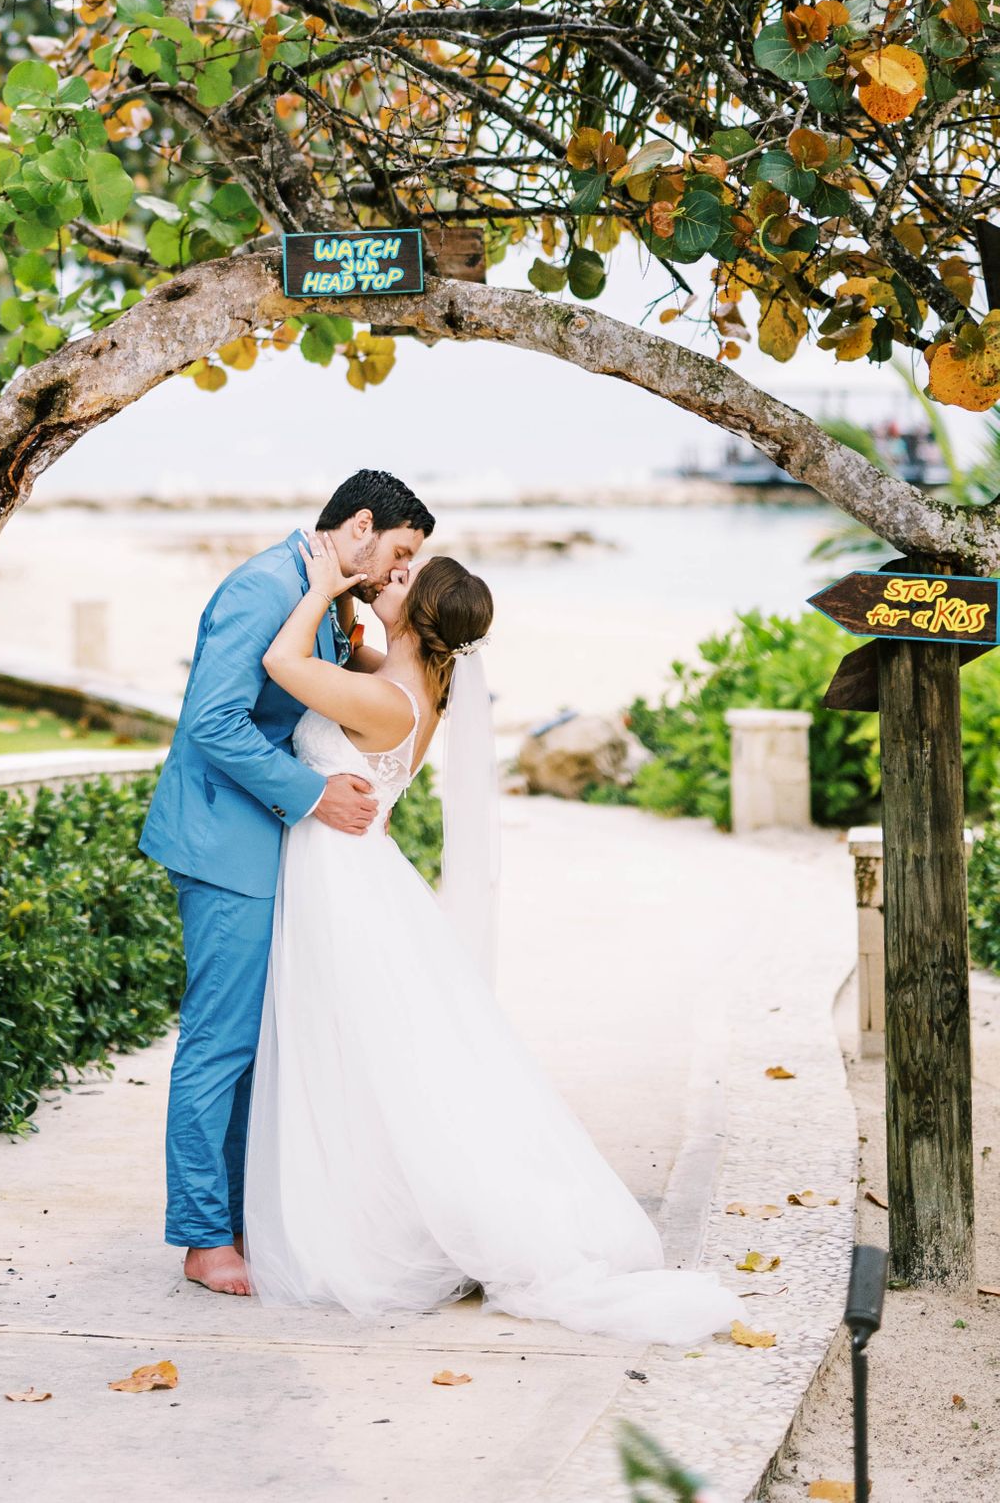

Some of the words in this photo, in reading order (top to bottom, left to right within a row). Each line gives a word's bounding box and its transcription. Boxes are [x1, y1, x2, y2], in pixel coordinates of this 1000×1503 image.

[313, 237, 402, 261] WATCH
[302, 271, 356, 294] HEAD
[357, 267, 404, 292] TOP
[884, 578, 948, 603] STOP
[865, 603, 910, 626] for
[911, 610, 934, 629] a
